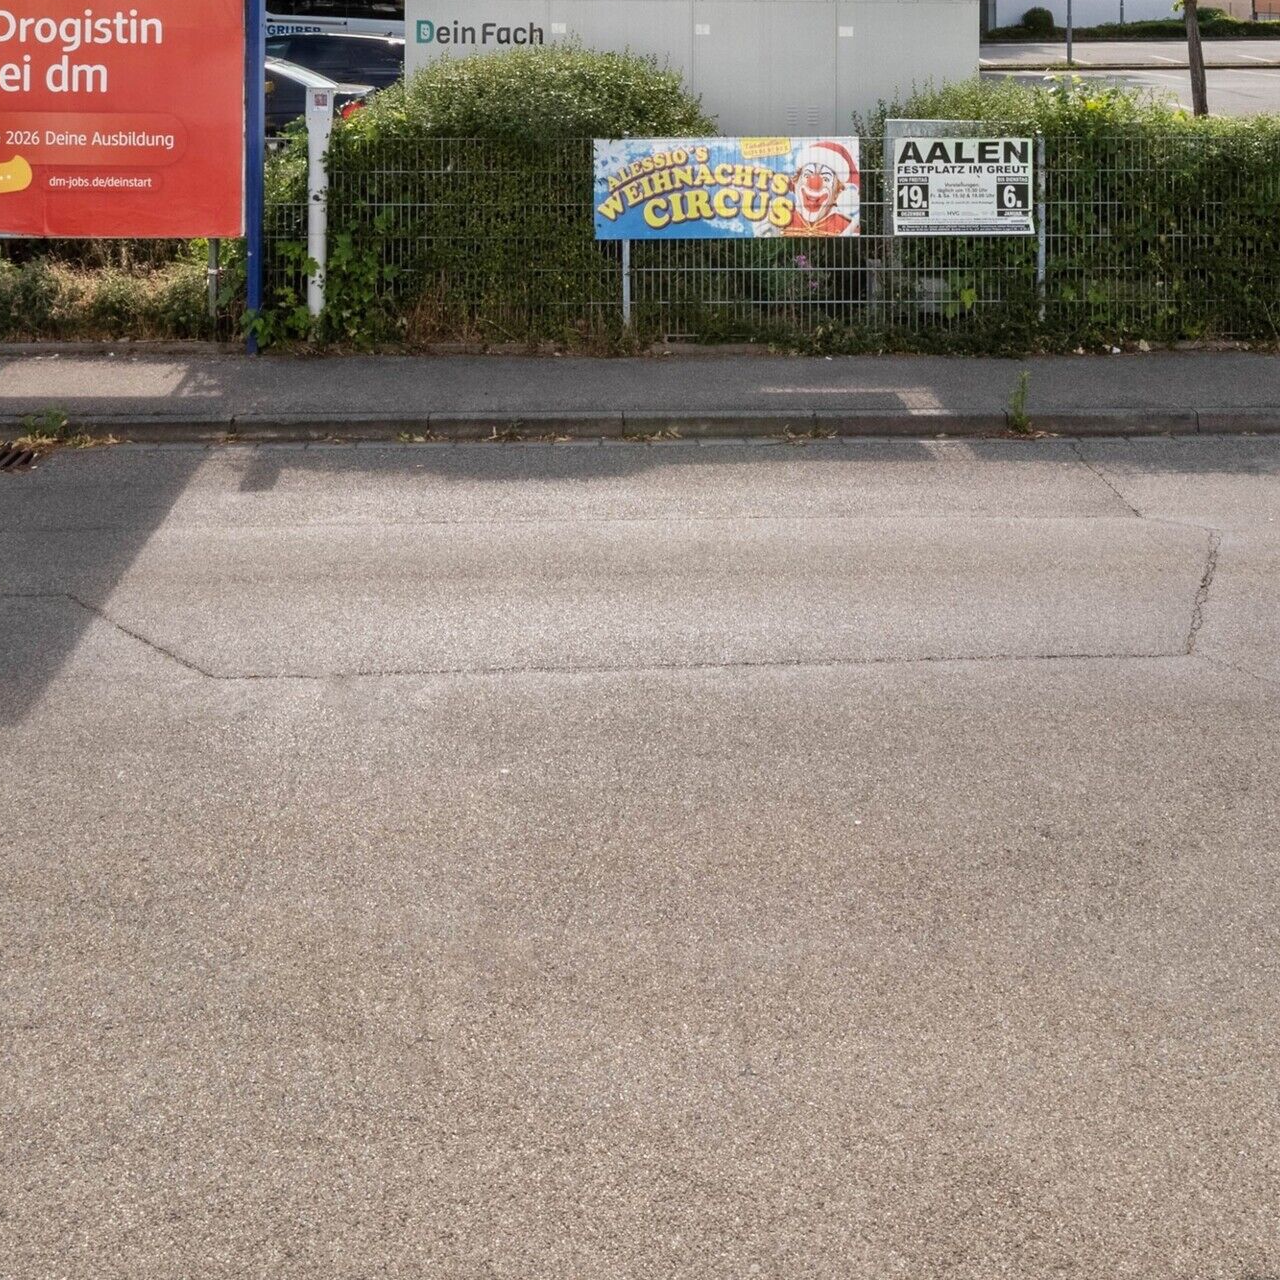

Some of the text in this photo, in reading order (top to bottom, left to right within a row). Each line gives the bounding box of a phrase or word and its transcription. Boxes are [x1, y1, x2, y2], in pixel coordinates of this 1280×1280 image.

[45, 54, 109, 93] dm
[5, 130, 40, 146] 2026
[45, 129, 87, 147] Deine
[91, 128, 174, 150] Ausbildung
[898, 141, 1028, 164] AALEN
[897, 165, 1028, 174] FESTPLATZ IM GREUT
[48, 175, 152, 189] dm-jobs.de/deinstart
[597, 162, 790, 220] WEIHNACHTS
[899, 185, 928, 209] 19.
[1003, 185, 1022, 208] 6.
[643, 188, 794, 229] CIRCUS
